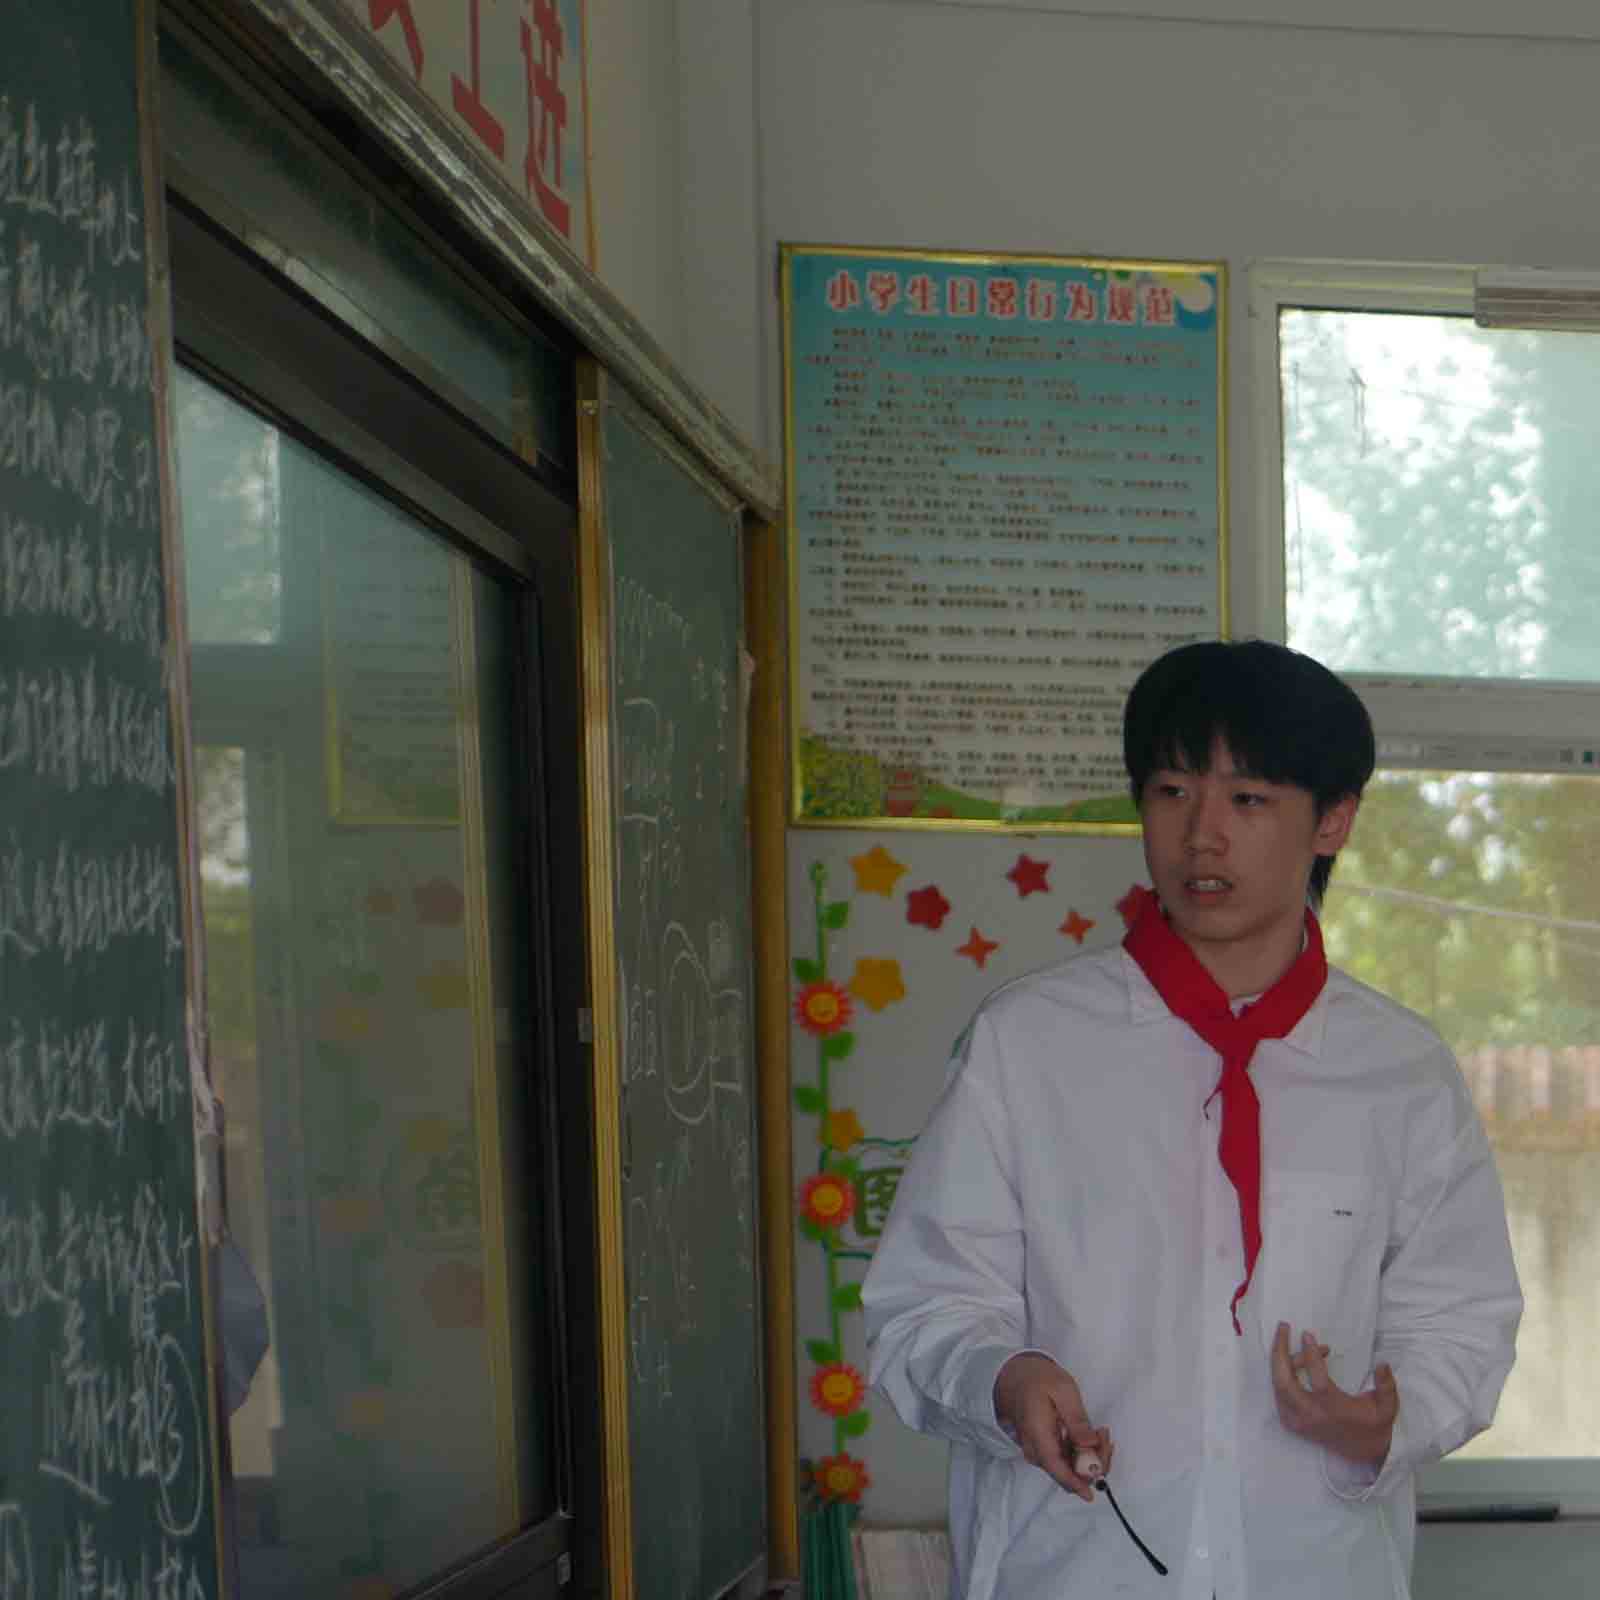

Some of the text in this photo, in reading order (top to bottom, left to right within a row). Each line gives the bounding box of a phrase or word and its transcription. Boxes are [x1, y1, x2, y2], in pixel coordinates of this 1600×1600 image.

[826, 270, 1178, 327] 小学生日常行为规范
